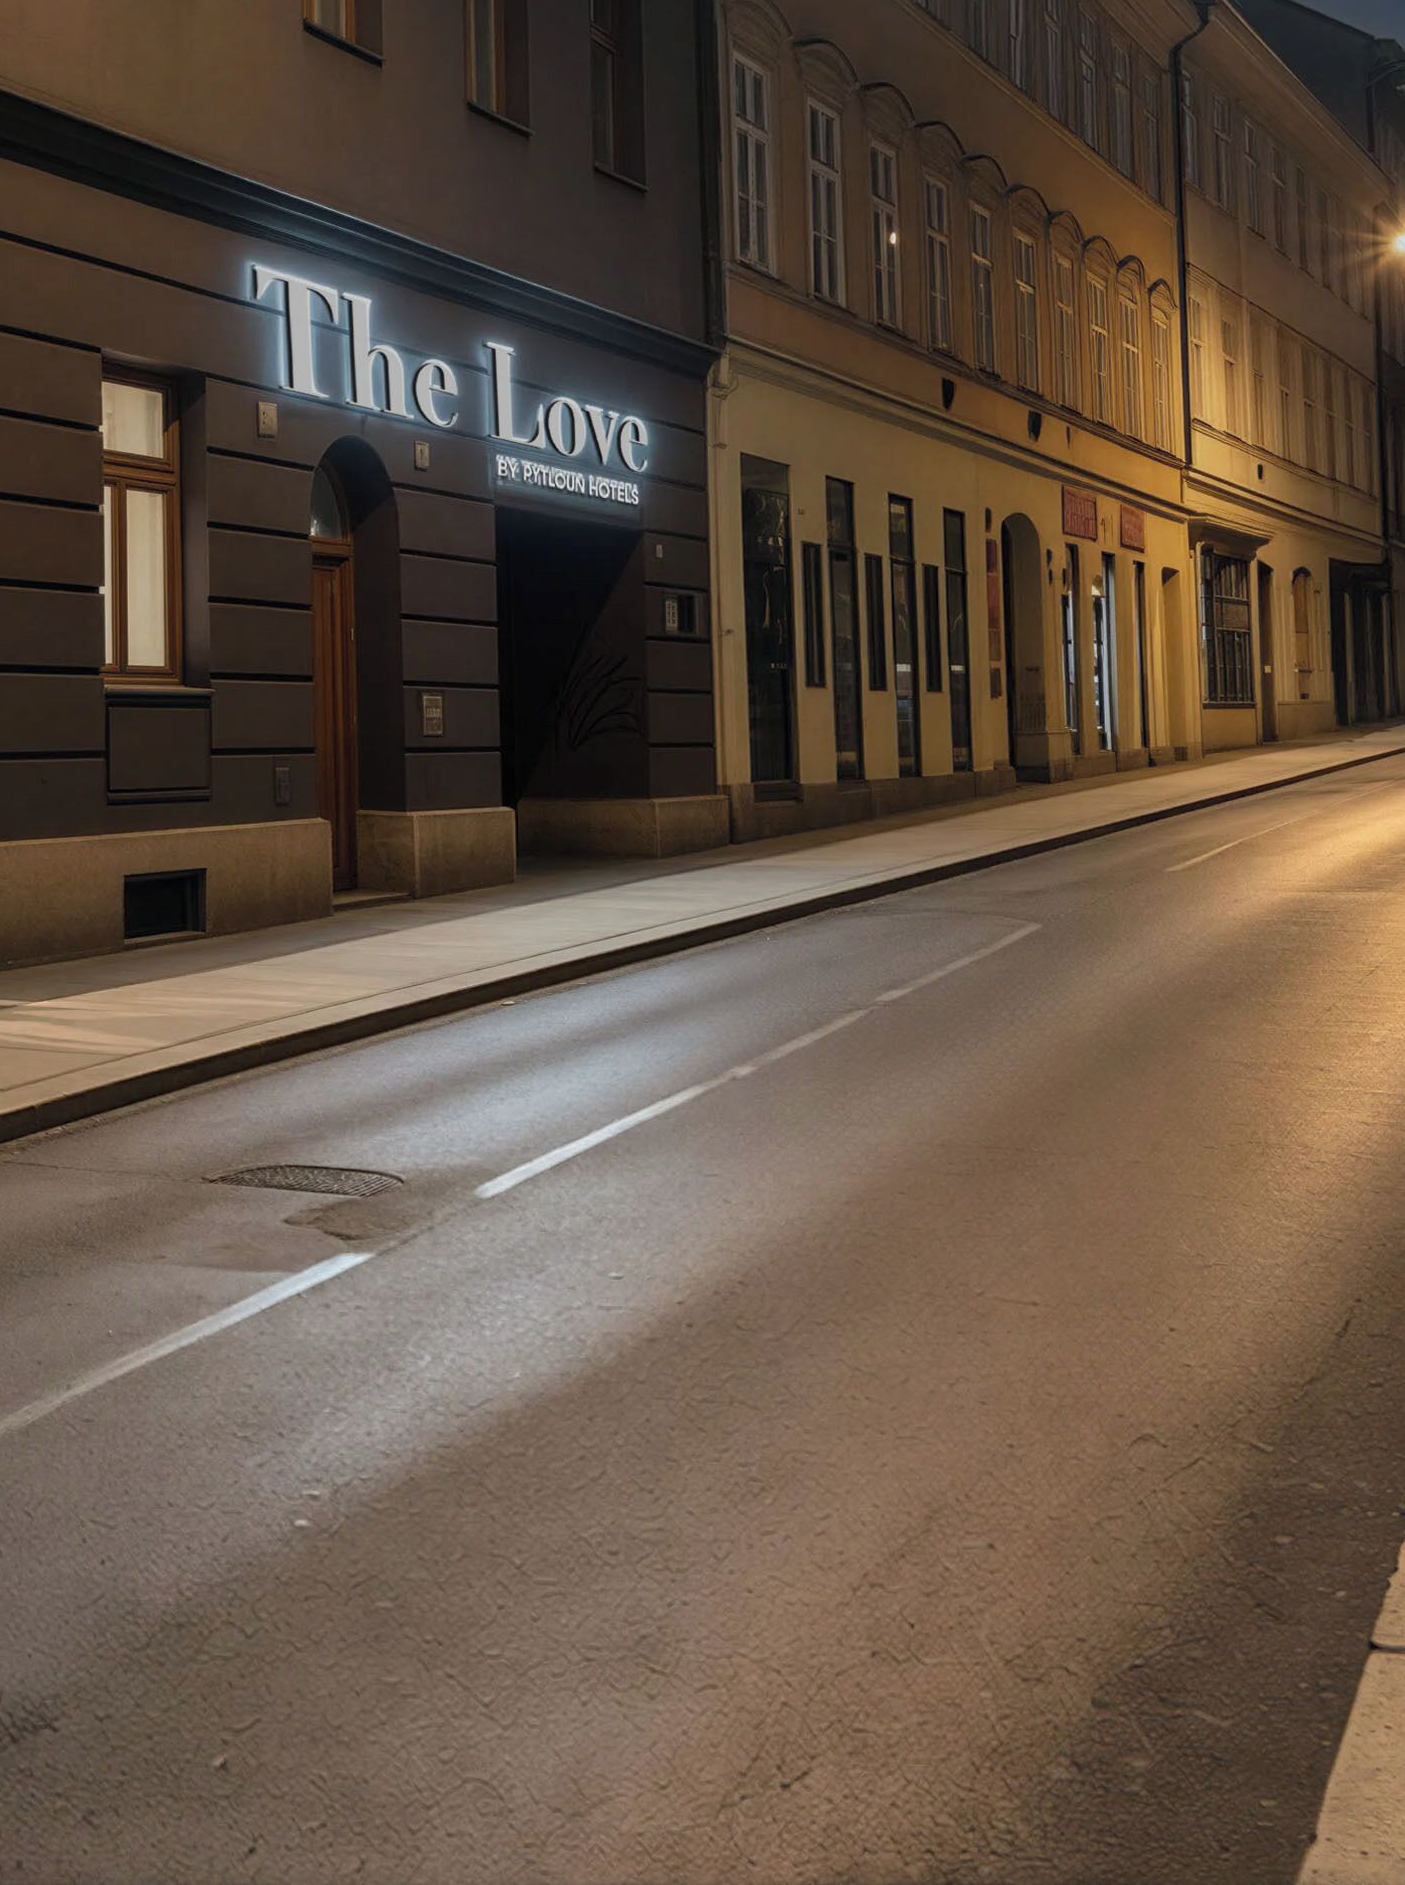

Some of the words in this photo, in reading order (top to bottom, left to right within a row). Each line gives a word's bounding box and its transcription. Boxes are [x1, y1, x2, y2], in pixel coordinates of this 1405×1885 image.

[251, 264, 459, 428] The
[484, 341, 648, 473] Love
[497, 457, 519, 480] BY
[522, 461, 586, 495] PYTLOUN
[589, 476, 640, 506] HOTELS
